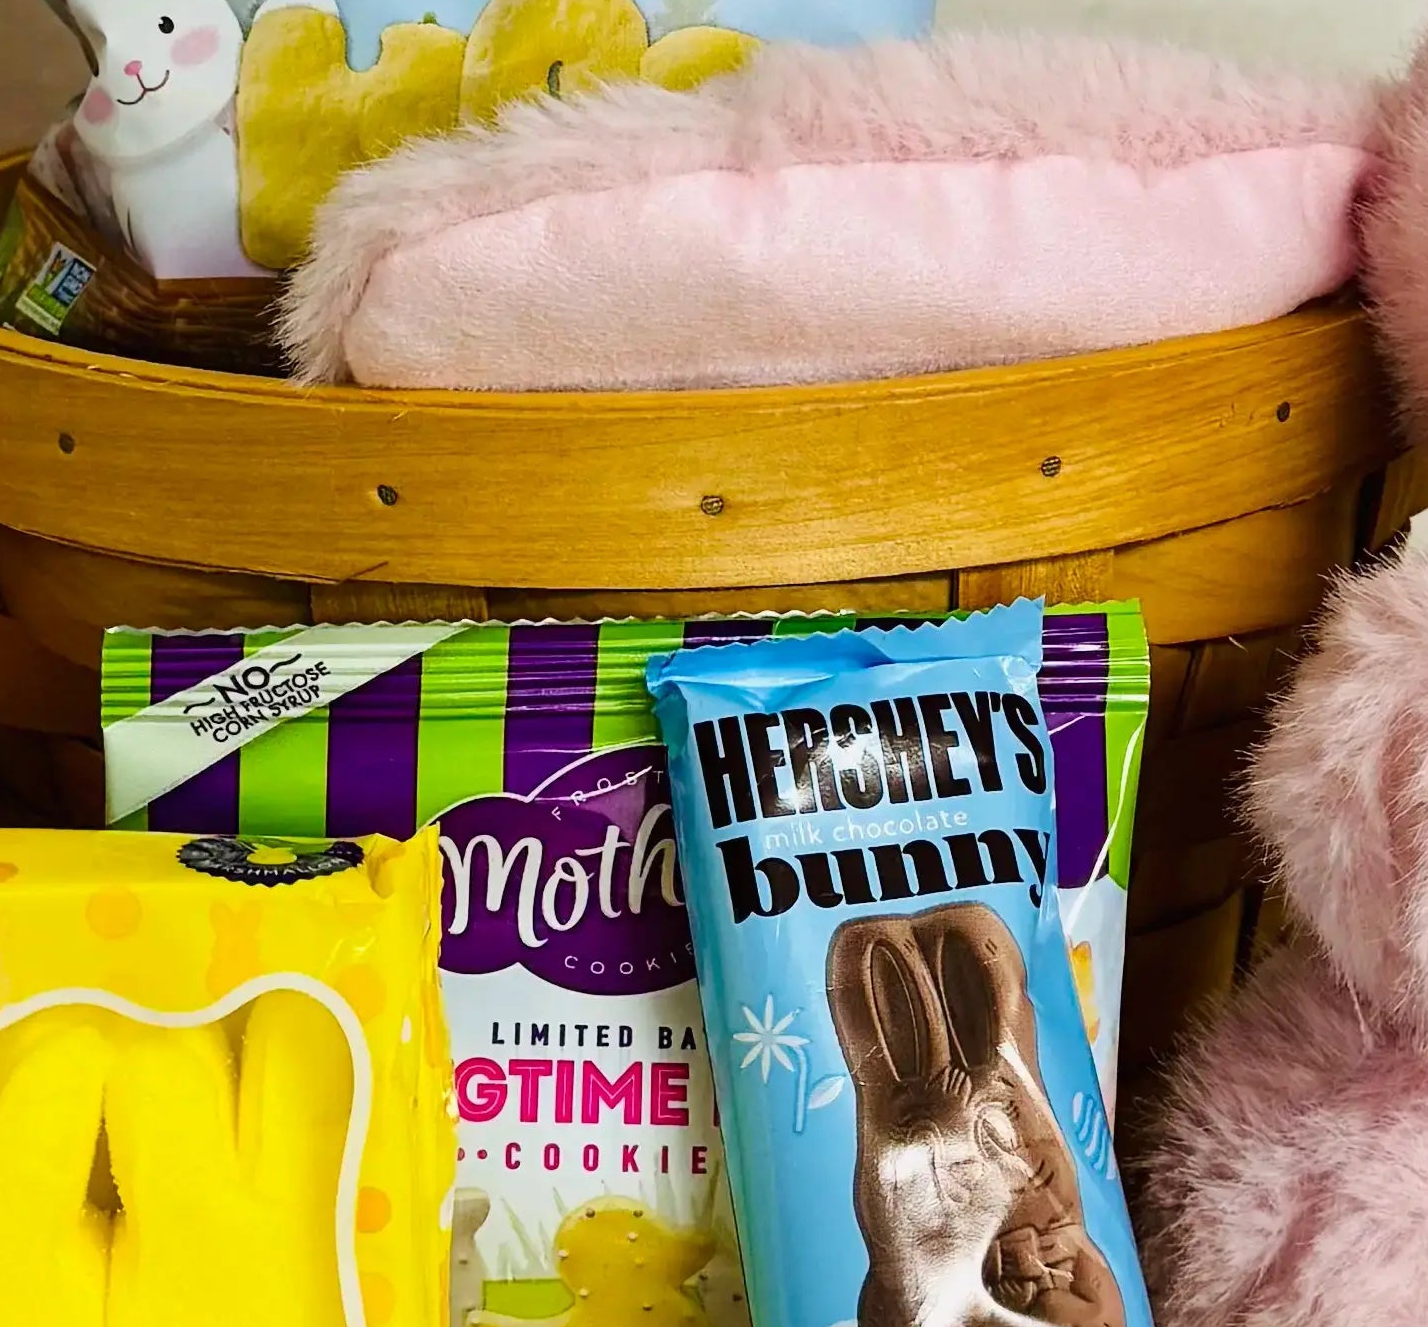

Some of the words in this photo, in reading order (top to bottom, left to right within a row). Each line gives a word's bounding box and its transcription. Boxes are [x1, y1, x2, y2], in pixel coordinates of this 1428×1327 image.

[190, 705, 242, 736] HIGH
[240, 661, 331, 712] FRUCTOSE
[212, 710, 269, 743] CORN
[268, 685, 320, 717] SYRUP
[213, 666, 270, 704] NO
[693, 691, 1048, 829] HERSHEY'S
[764, 822, 823, 850] milk
[833, 810, 968, 842] chocolate
[715, 828, 1051, 924] bunny
[491, 1022, 633, 1048] LIMITED
